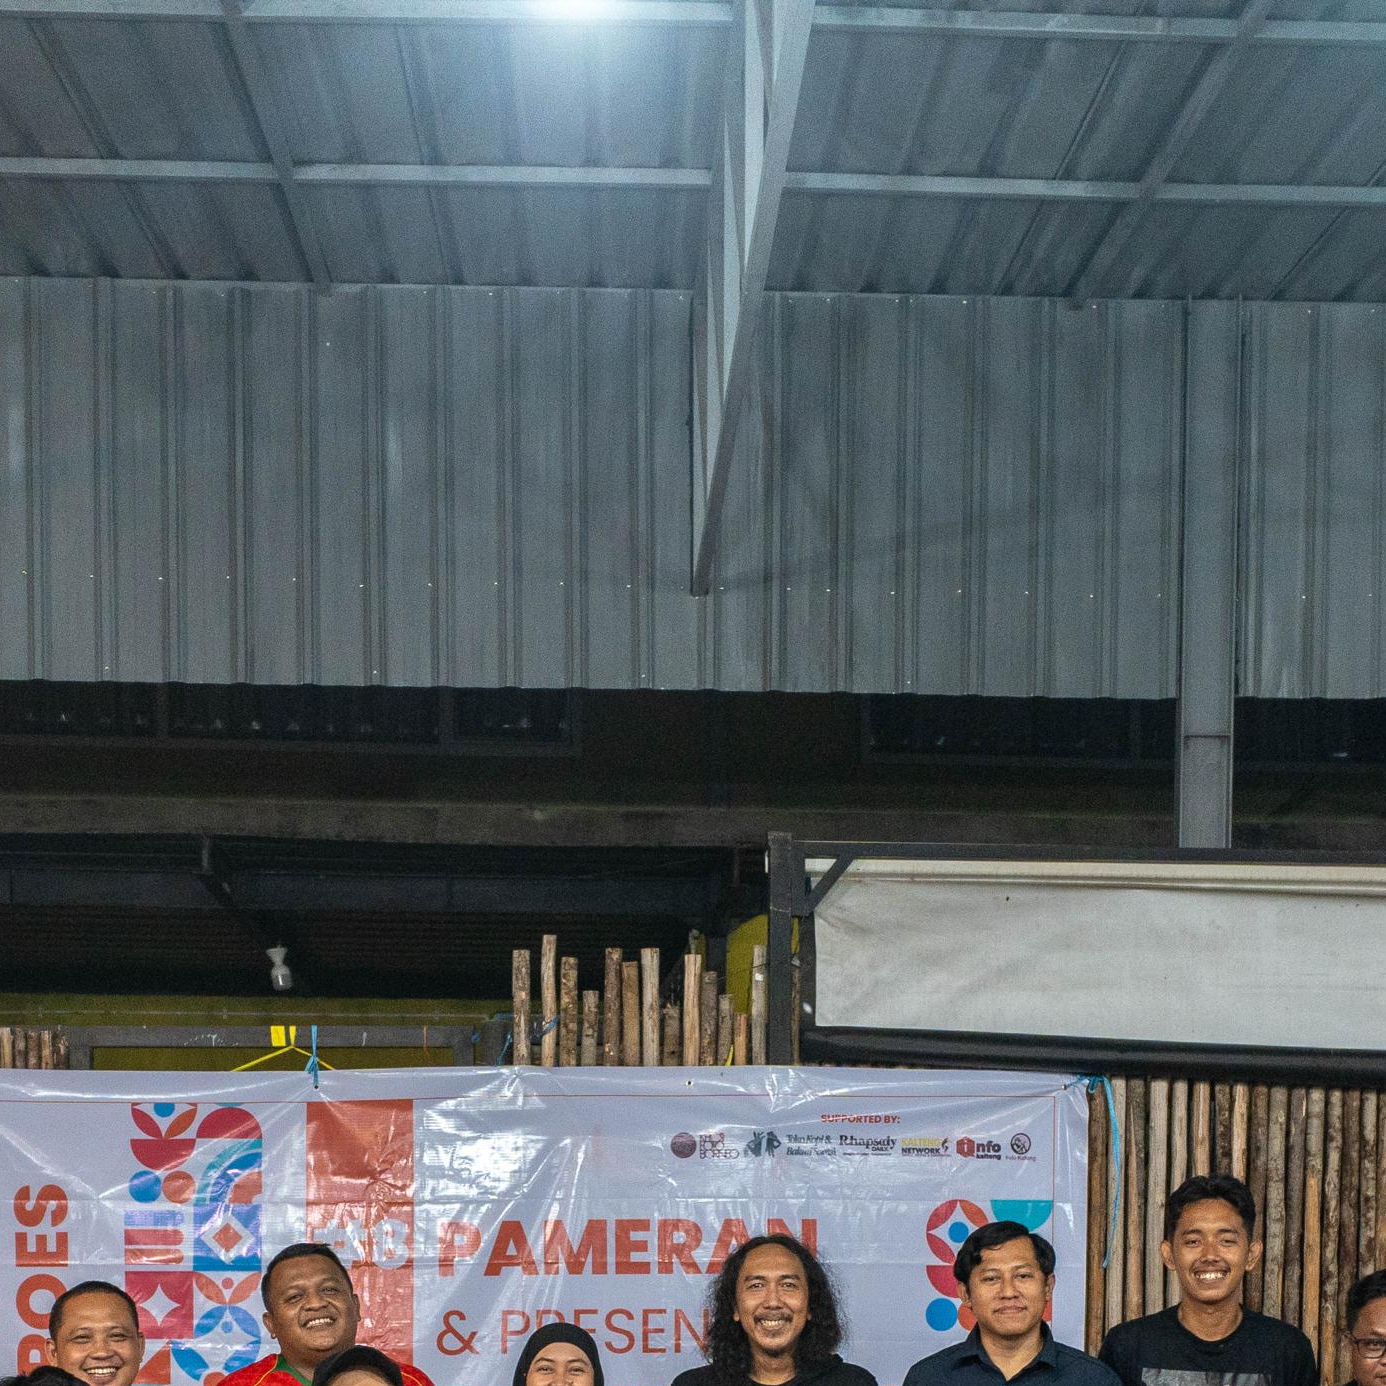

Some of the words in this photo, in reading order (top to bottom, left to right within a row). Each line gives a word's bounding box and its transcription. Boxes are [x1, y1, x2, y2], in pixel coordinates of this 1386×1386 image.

[821, 1114, 881, 1124] SUPPORTED
[884, 1115, 901, 1124] BY:
[839, 1134, 898, 1150] Rhapsody
[436, 1310, 479, 1355] &
[501, 1309, 717, 1355] PRESEN
